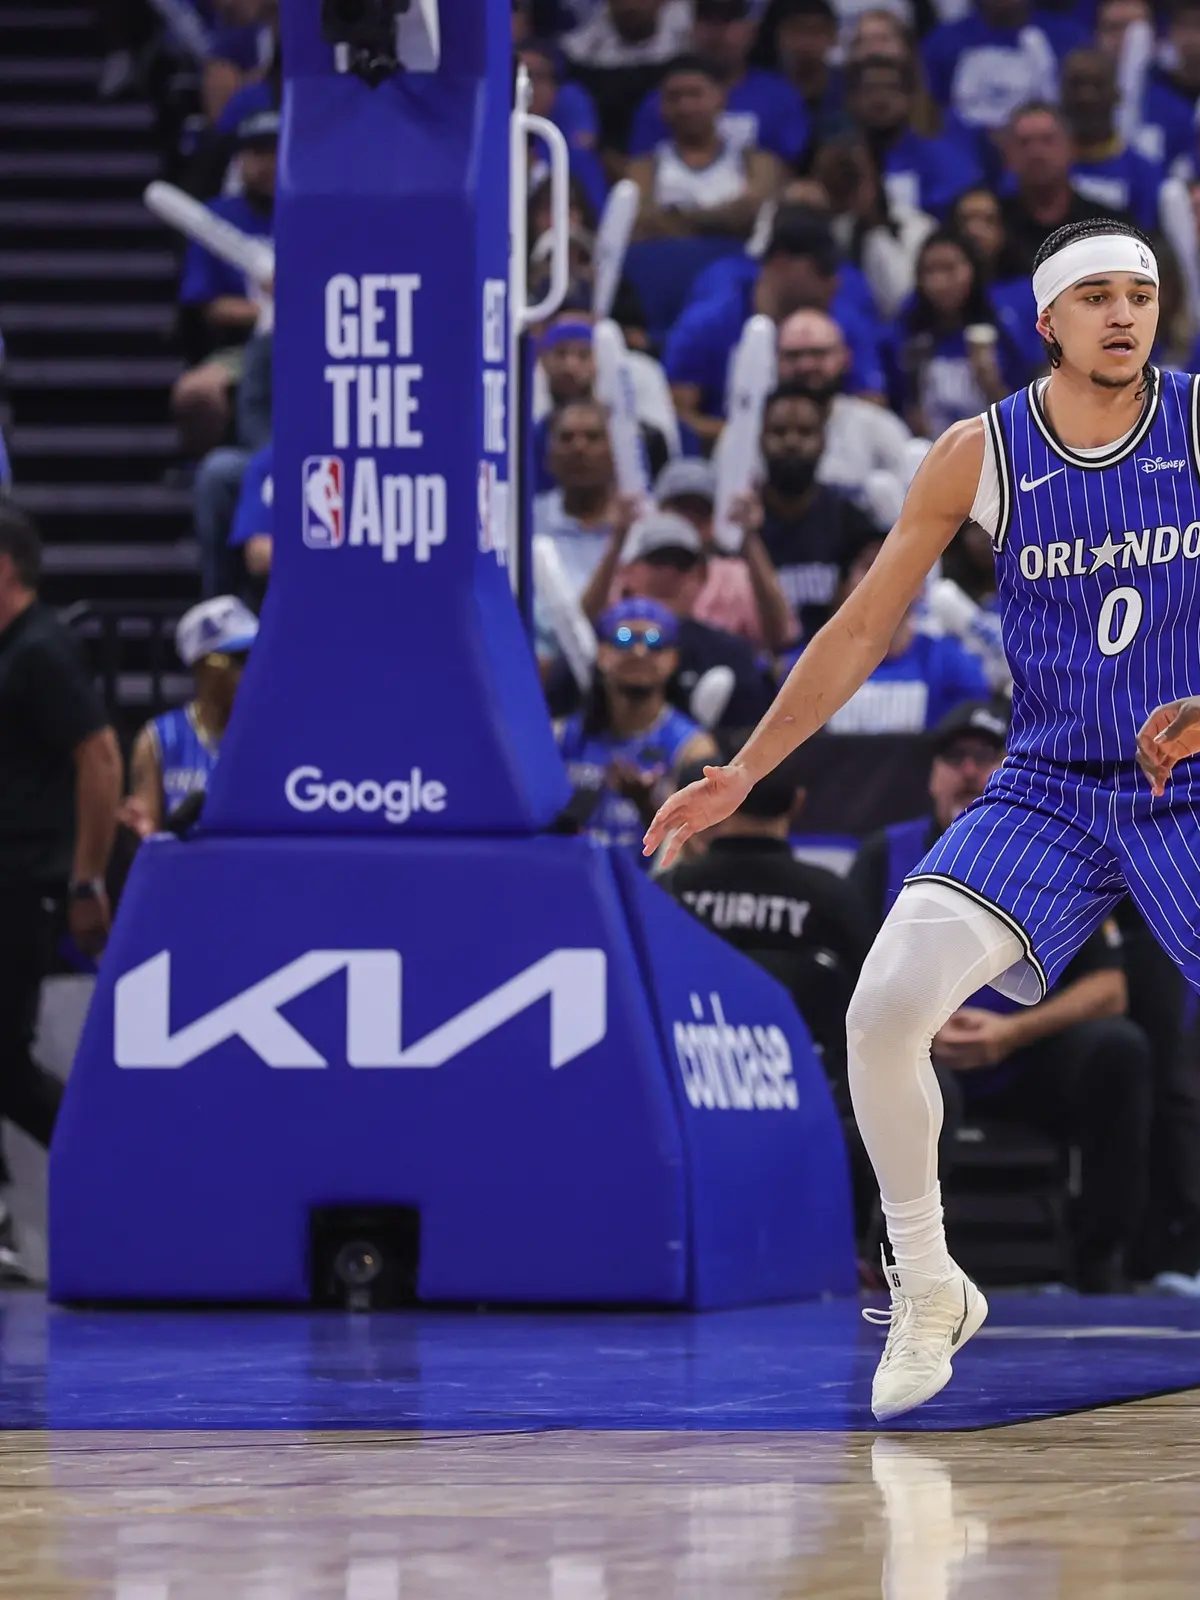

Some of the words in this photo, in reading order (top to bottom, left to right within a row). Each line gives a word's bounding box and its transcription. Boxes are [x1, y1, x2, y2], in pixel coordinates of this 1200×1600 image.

[325, 274, 421, 359] GET
[324, 364, 423, 448] THE
[348, 457, 447, 563] App
[1097, 586, 1143, 656] 0
[284, 765, 447, 824] Google
[682, 890, 810, 937] CURITY
[114, 948, 607, 1070] KIA
[673, 991, 799, 1110] coinbase
